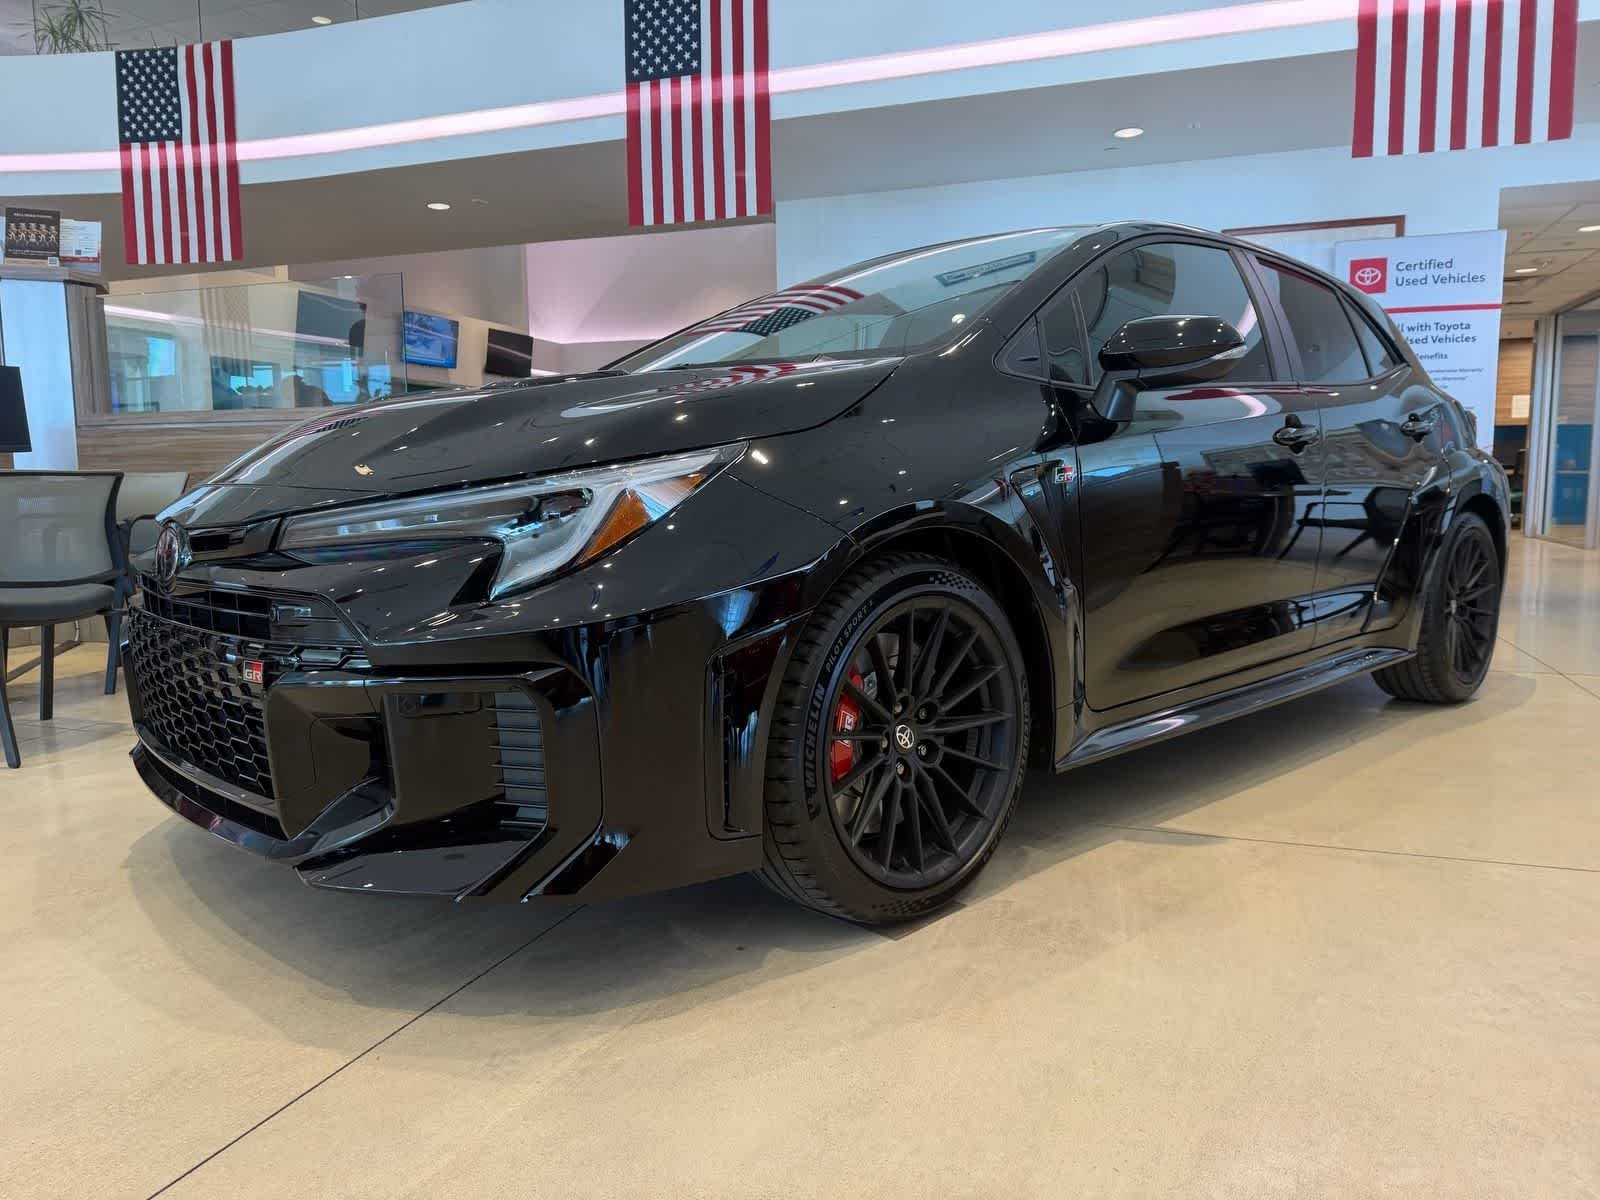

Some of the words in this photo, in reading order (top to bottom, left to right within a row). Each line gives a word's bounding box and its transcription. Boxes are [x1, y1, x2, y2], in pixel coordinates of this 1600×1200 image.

[1395, 258, 1454, 272] Certified
[1395, 274, 1428, 287] Used
[1431, 272, 1487, 285] Vehicles
[1407, 322, 1431, 332] with
[1434, 321, 1471, 333] Toyota
[1406, 335, 1429, 345] sed
[1431, 334, 1477, 344] Vehicles
[826, 637, 844, 672] PILOT
[805, 683, 825, 788] MICHELIN
